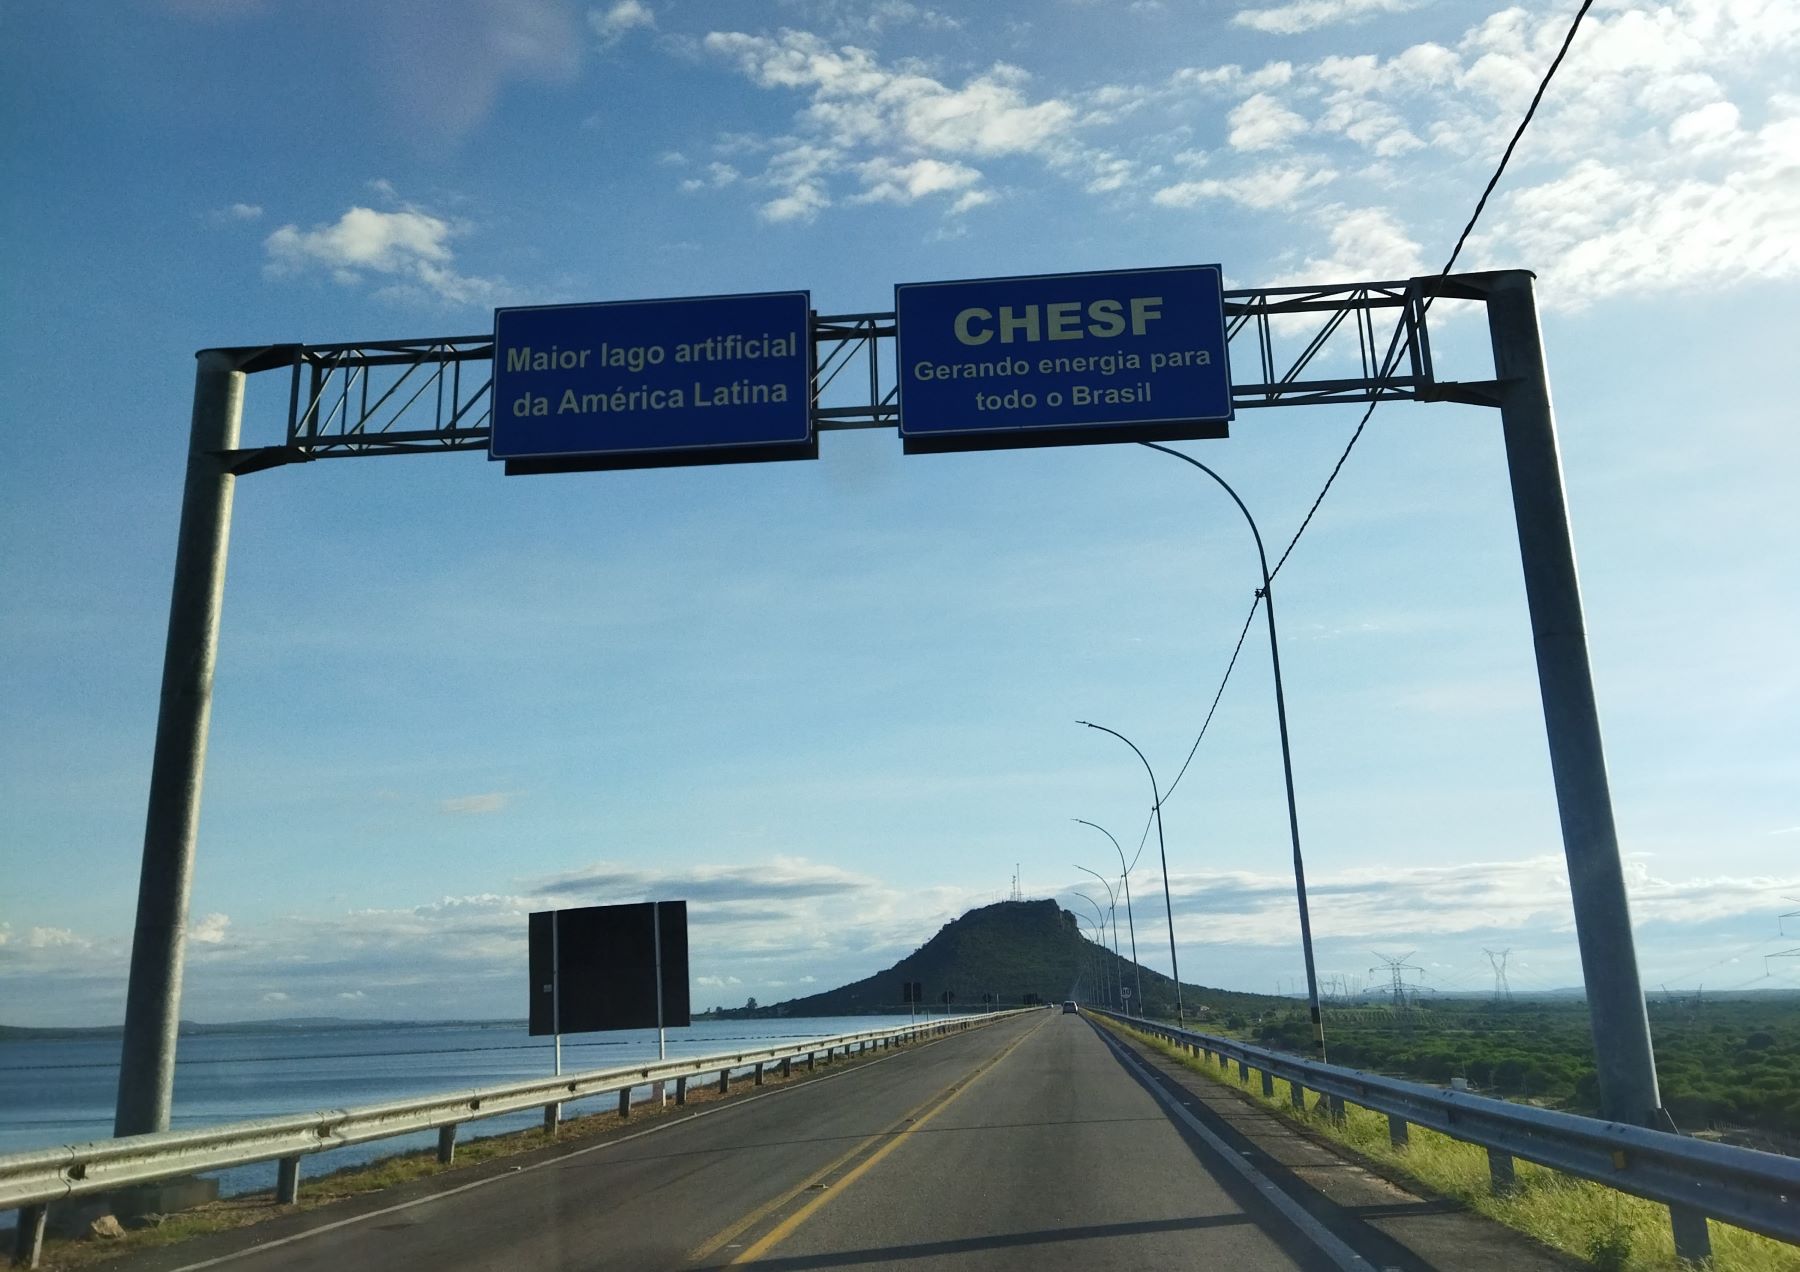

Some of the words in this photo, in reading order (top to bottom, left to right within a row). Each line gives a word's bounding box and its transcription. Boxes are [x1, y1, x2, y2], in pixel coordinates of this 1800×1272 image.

[954, 297, 1163, 345] CHESF
[506, 346, 591, 372] Maior
[601, 342, 665, 372] lago
[674, 332, 796, 362] artificial
[914, 356, 1030, 381] Gerando
[1038, 350, 1141, 376] energia
[1150, 350, 1211, 373] para
[512, 392, 548, 417] da
[557, 386, 684, 415] América
[694, 380, 788, 407] Latina
[975, 389, 1037, 411] todo
[1046, 392, 1063, 407] o
[1072, 382, 1152, 406] Brasil
